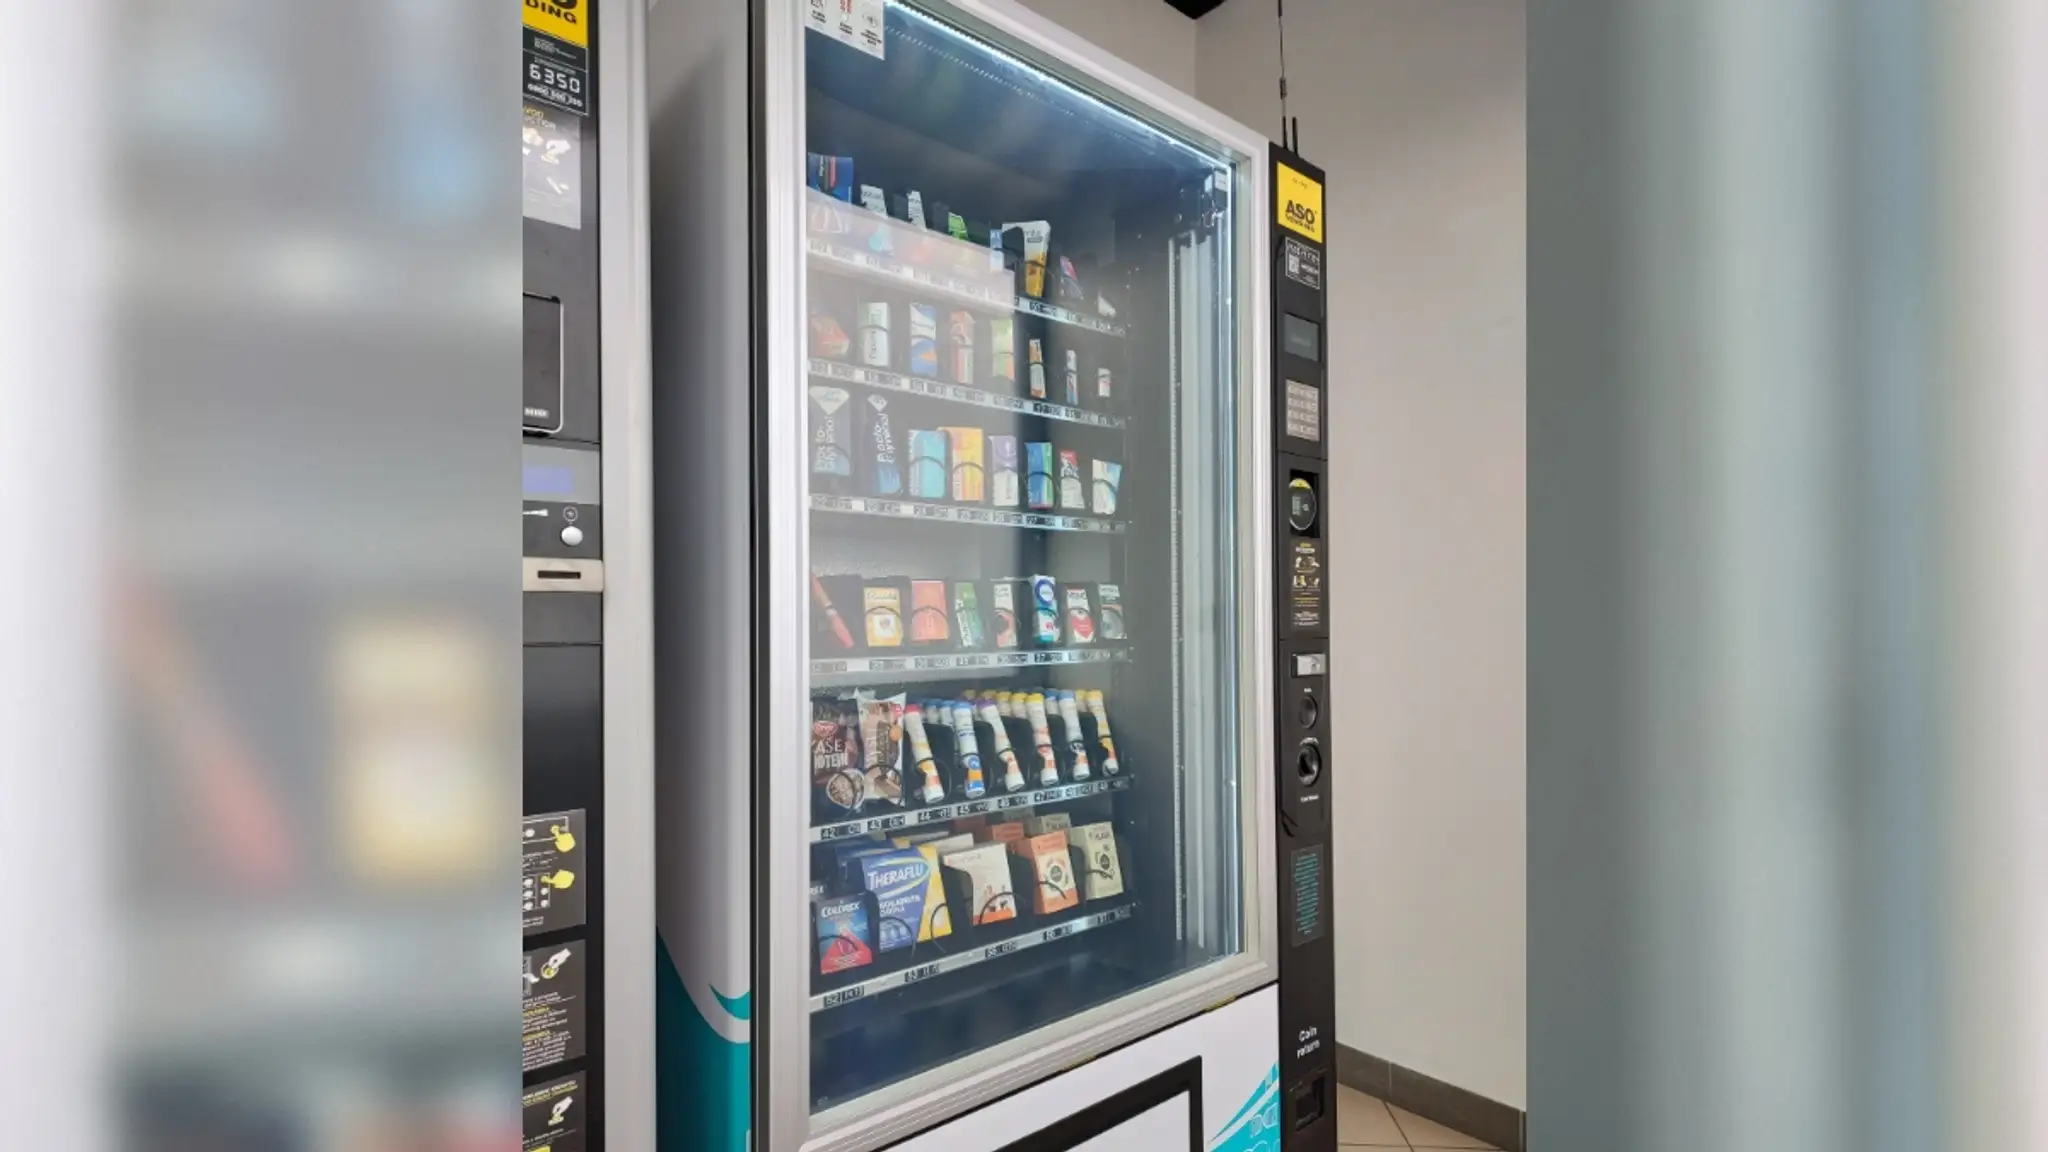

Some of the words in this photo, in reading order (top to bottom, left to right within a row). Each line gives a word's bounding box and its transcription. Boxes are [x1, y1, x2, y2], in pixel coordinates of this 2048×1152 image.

[529, 63, 581, 93] 6350
[1285, 200, 1315, 225] ASO
[867, 864, 924, 891] THERAFLU
[1299, 1025, 1317, 1041] Coin
[1297, 1040, 1320, 1059] return
